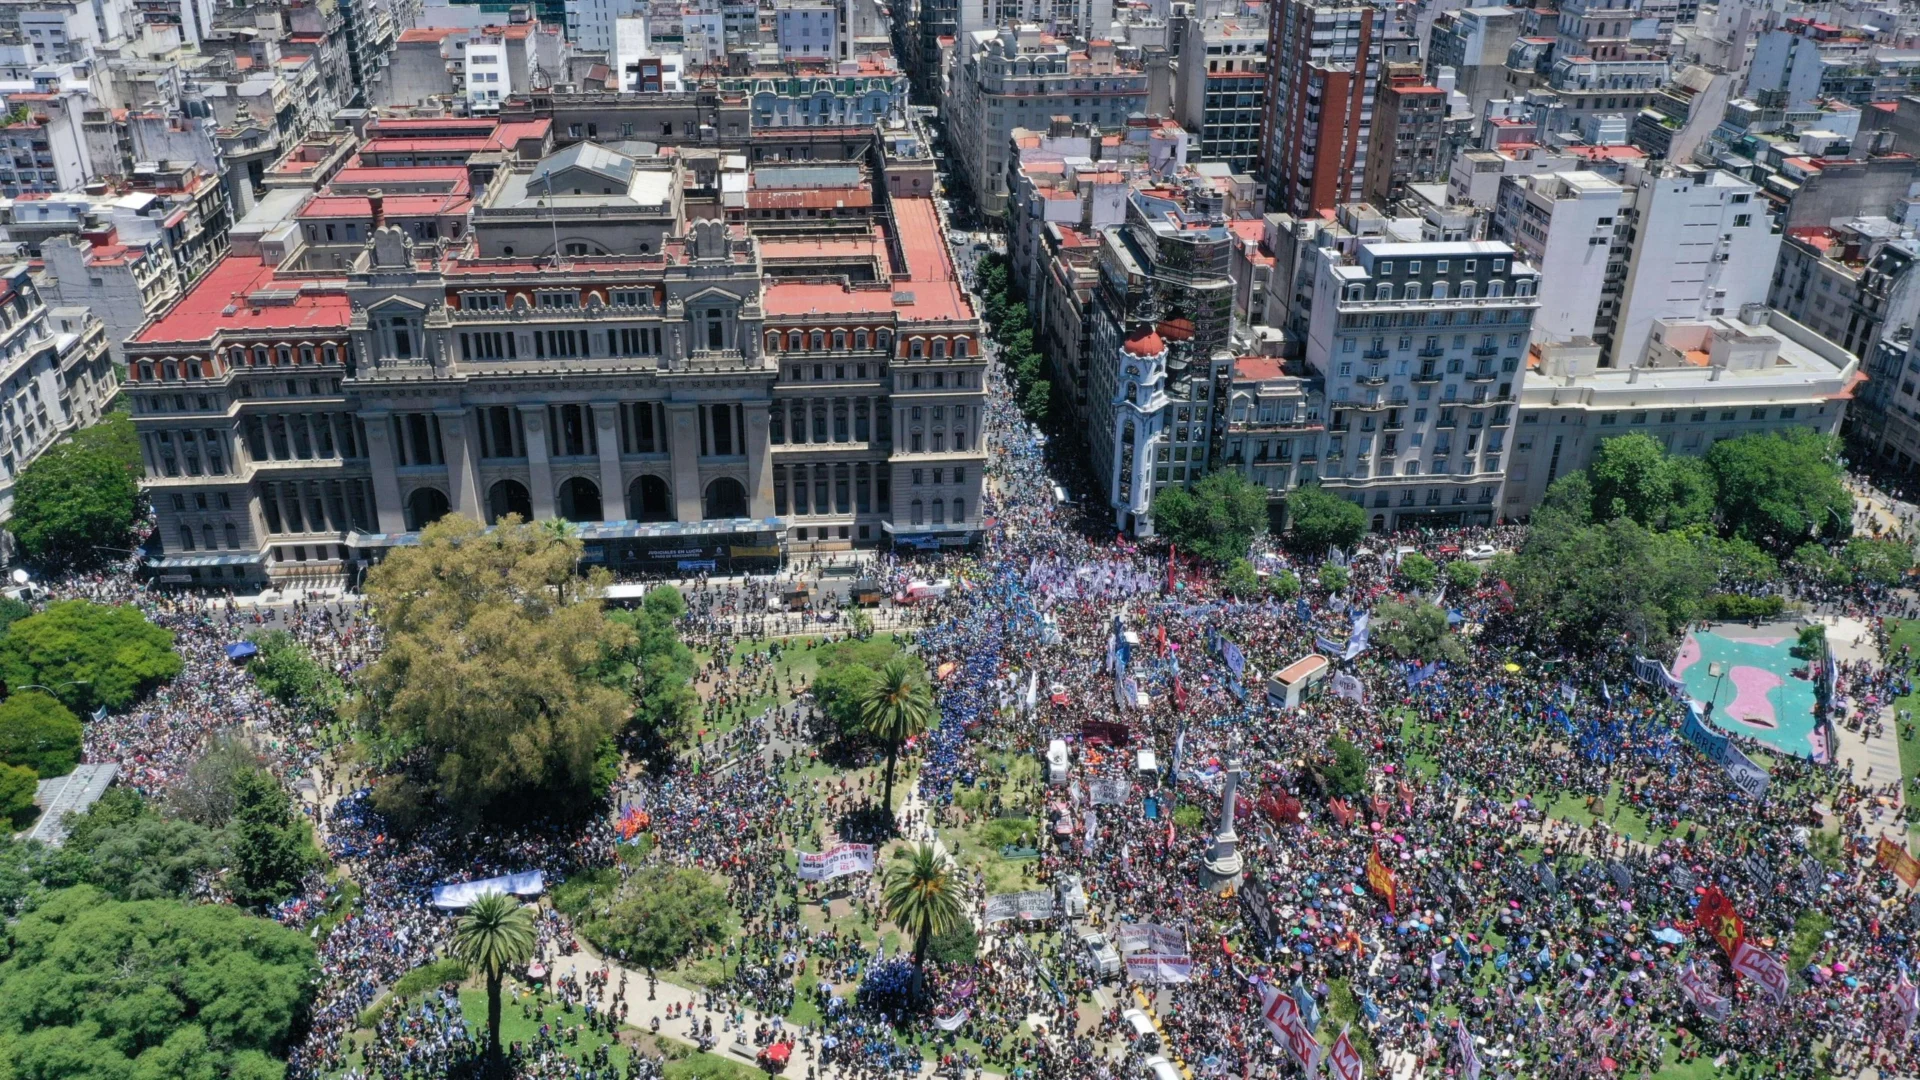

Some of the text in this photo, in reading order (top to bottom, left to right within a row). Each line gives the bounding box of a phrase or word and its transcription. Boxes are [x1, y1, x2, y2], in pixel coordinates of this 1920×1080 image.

[1684, 719, 1723, 760] LIBRES
[1724, 755, 1735, 773] DEL
[1736, 768, 1759, 794] SUR
